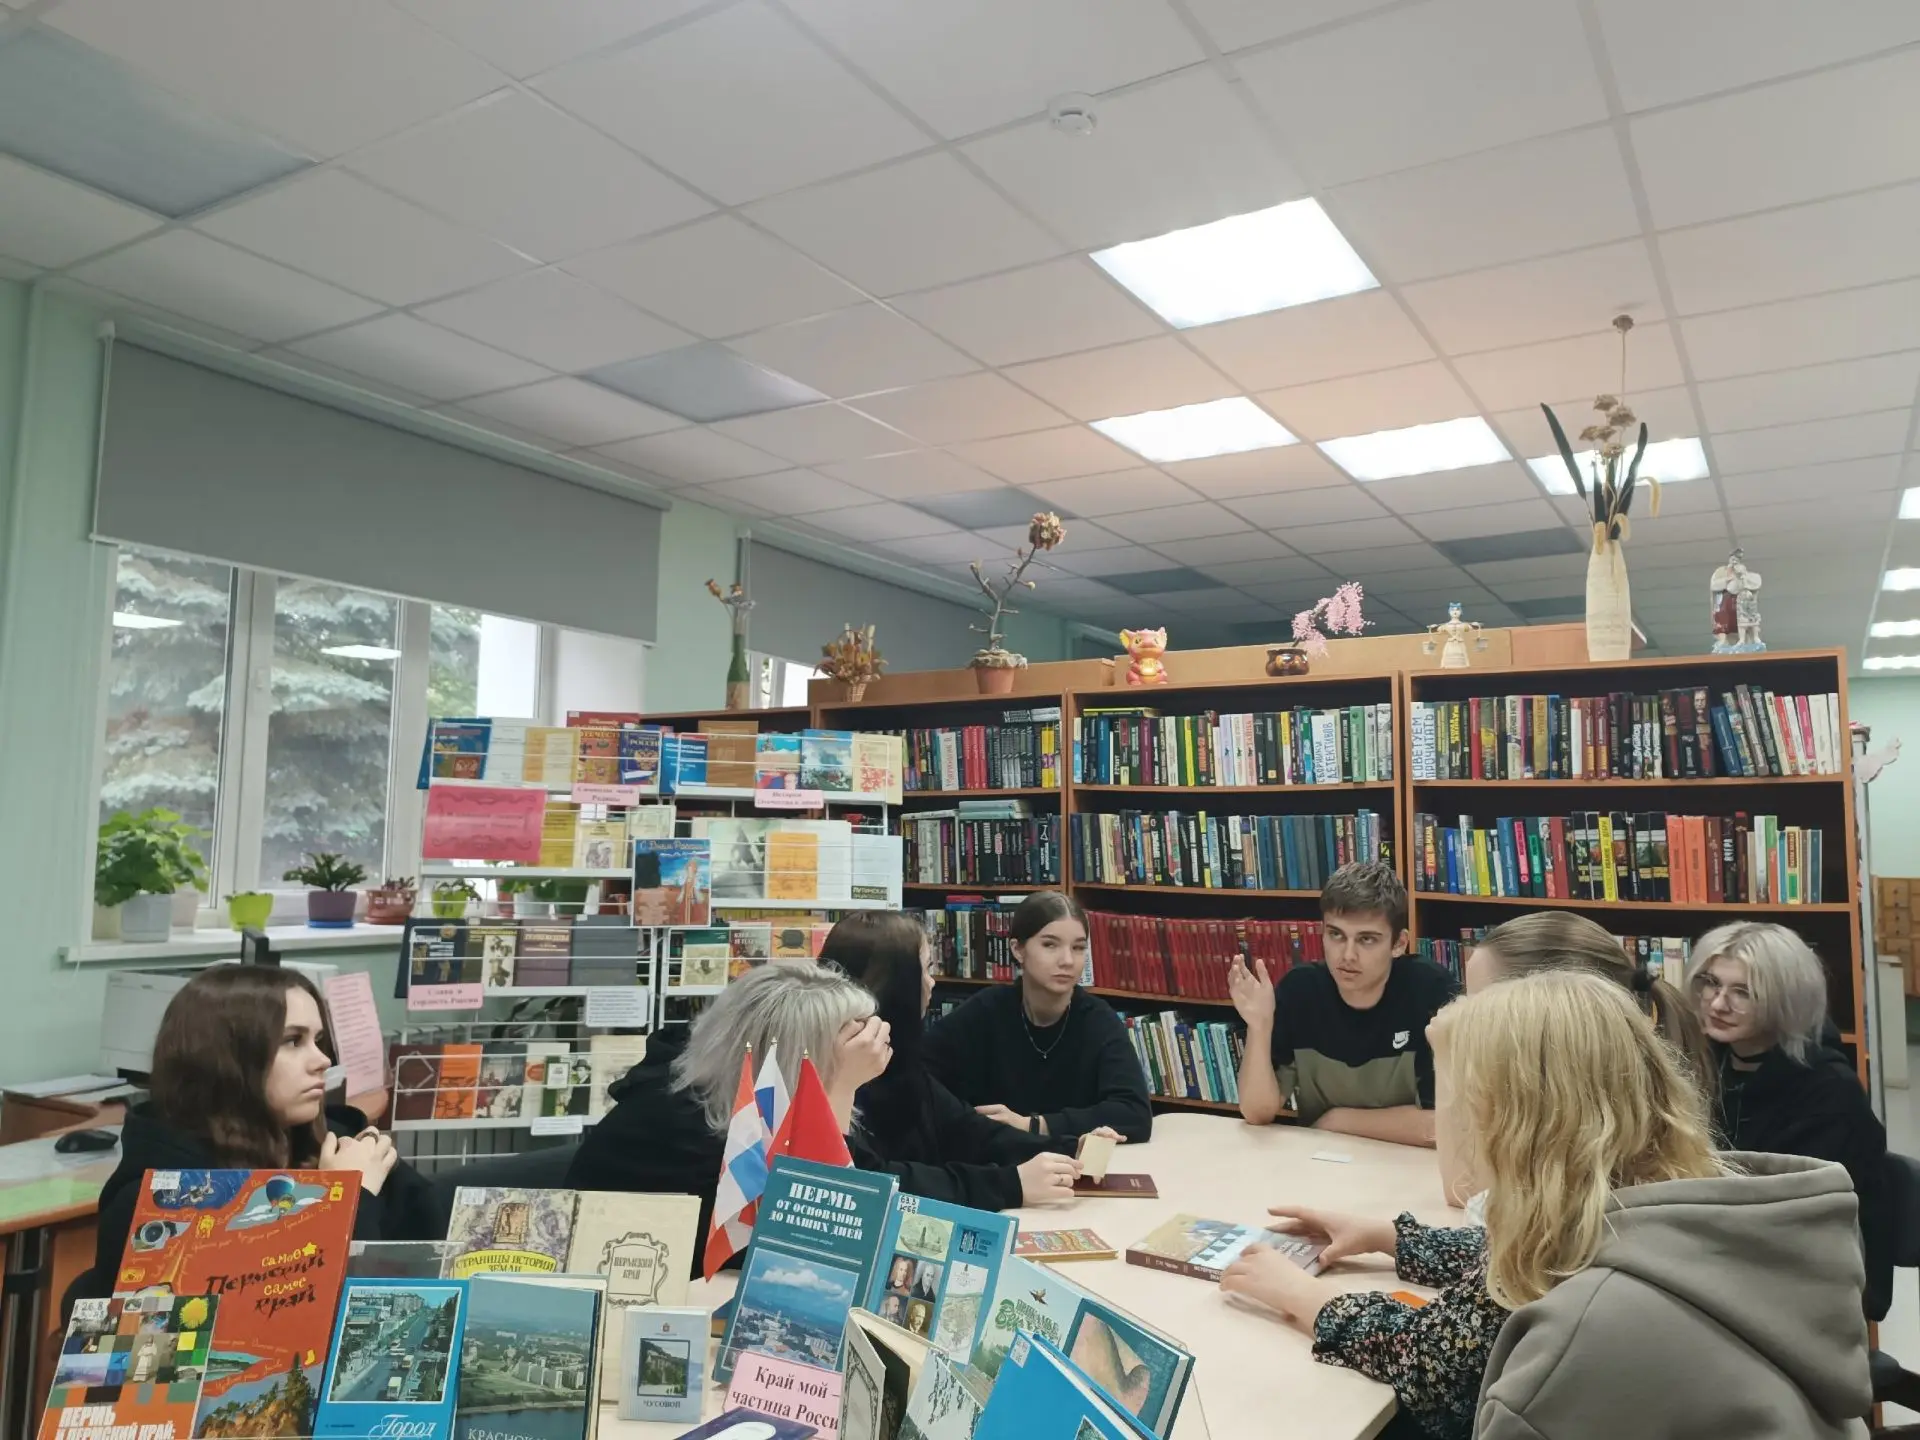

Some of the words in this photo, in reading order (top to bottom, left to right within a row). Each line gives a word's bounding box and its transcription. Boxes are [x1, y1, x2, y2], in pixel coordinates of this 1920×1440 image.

[1323, 722, 1338, 779] ДЕТЕКТИВОВ
[1412, 717, 1424, 778] СОВЕТУЕМ
[1424, 713, 1436, 778] ПРОЧИТАТЬ
[789, 1183, 857, 1211] ПЕРМЬ
[769, 1210, 784, 1222] ДО
[785, 1213, 830, 1233] НАШИХ
[830, 1224, 863, 1241] ДНЕЙ
[776, 1199, 792, 1211] ОТ
[793, 1203, 863, 1228] ОСНОВАНИЯ
[455, 1254, 511, 1269] СТРАНИЦЫ
[511, 1255, 556, 1274] ИСТОРИИ
[613, 1256, 654, 1269] ПЕРМСКИЙ
[622, 1269, 642, 1280] КРАЙ
[755, 1366, 795, 1390] Край
[799, 1381, 828, 1399] мой
[58, 1405, 117, 1428] ПЕРМЬ
[642, 1399, 682, 1409] ЧУСОВОЙ
[732, 1391, 791, 1418] частица
[795, 1404, 839, 1430] Росси
[368, 1413, 438, 1440] Город
